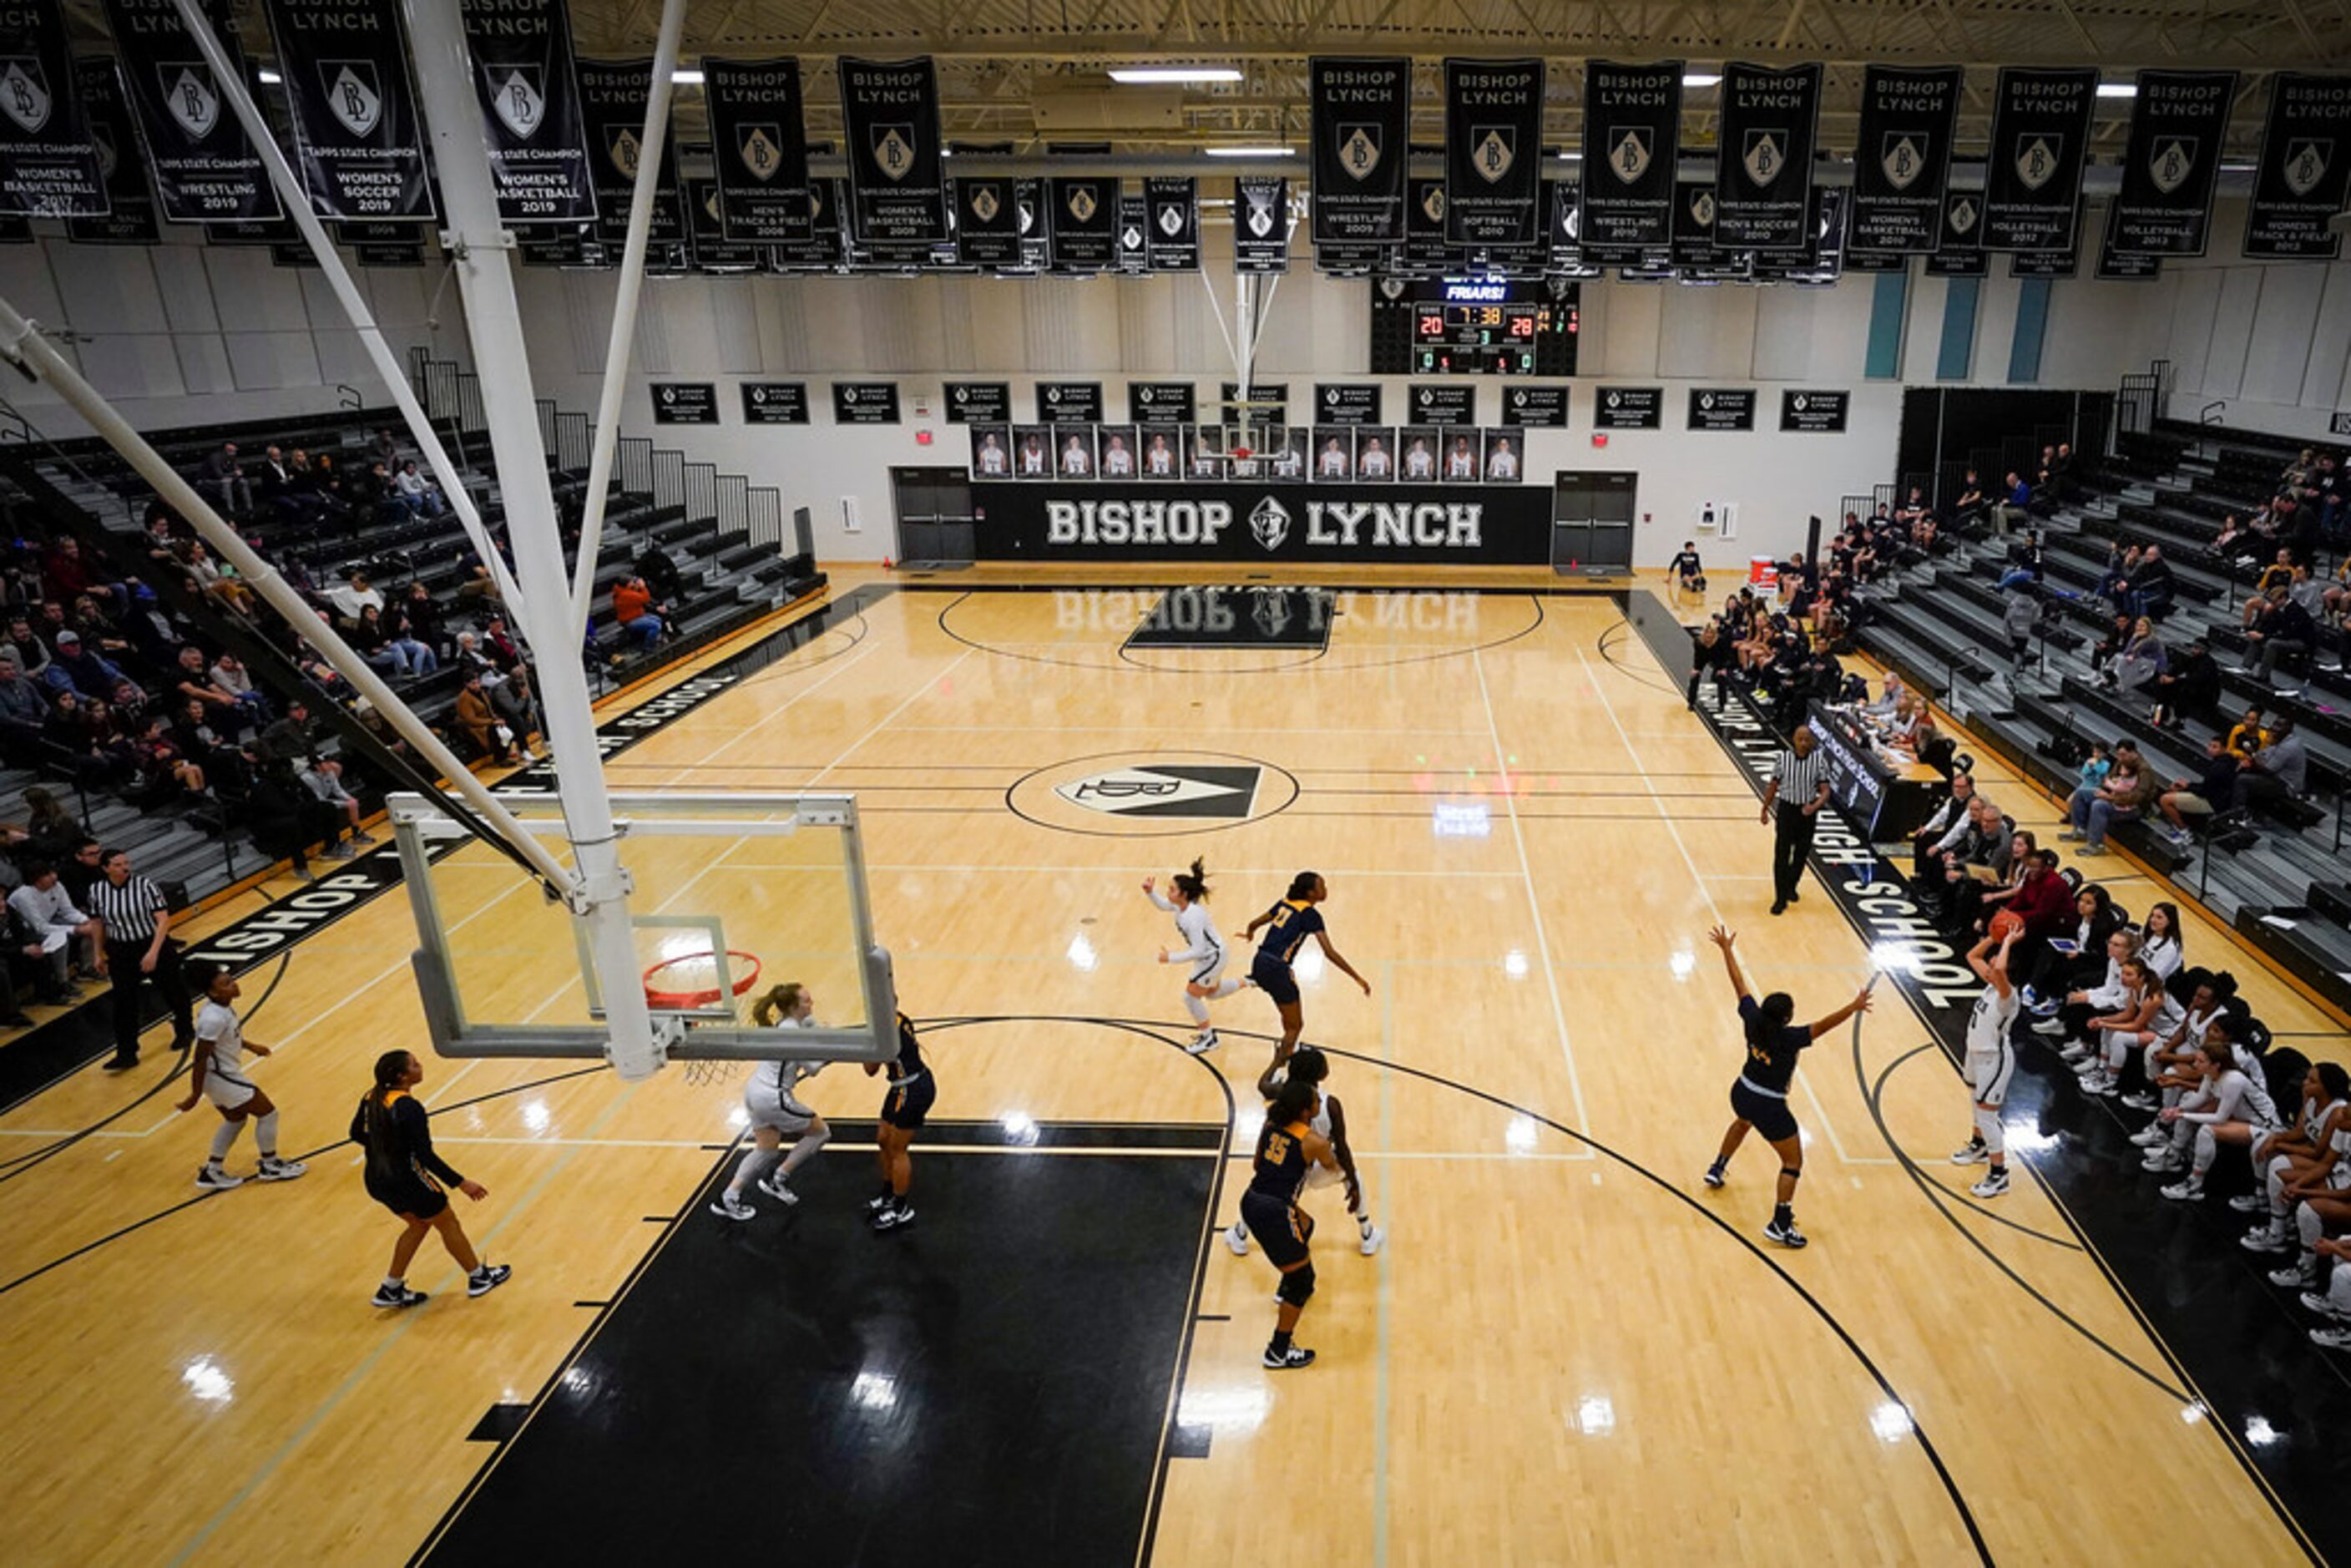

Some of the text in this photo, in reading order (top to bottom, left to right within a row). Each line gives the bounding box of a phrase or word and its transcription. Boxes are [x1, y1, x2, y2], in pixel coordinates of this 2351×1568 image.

[294, 13, 379, 30] LYNCH
[467, 18, 549, 35] LYNCH
[715, 72, 787, 85] BISHOP
[853, 73, 923, 85] BISHOP
[1323, 72, 1397, 84] BISHOP
[1459, 75, 1532, 88] BISHOP
[1598, 74, 1671, 89] BISHOP
[1737, 77, 1807, 91] BISHOP
[1876, 79, 1949, 95] BISHOP
[2011, 82, 2085, 96] BISHOP
[2149, 86, 2222, 100] BISHOP
[723, 90, 786, 102] LYNCH
[858, 90, 920, 102] LYNCH
[1326, 89, 1393, 102] LYNCH
[1462, 91, 1528, 104] LYNCH
[1601, 92, 1667, 106] LYNCH
[1737, 94, 1802, 108] LYNCH
[1878, 97, 1944, 111] LYNCH
[2014, 99, 2079, 113] LYNCH
[2149, 103, 2215, 117] LYNCH
[340, 148, 367, 157] STATE
[369, 147, 417, 158] CHAMPION
[530, 149, 583, 159] CHAMPION
[16, 168, 83, 180] WOMEN'S
[337, 173, 402, 184] WOMEN'S
[500, 174, 569, 185] WOMEN'S
[4, 181, 97, 193] BASKETBALL
[179, 184, 255, 195] WRESTLING
[343, 185, 401, 198] SOCCER
[496, 187, 581, 200] ASKETBALL
[40, 195, 73, 206] 2017
[204, 197, 238, 209] 2019
[358, 200, 392, 211] 2019
[522, 201, 557, 212] 2019
[752, 206, 786, 215] MEN'S
[877, 206, 927, 215] WOMEN'S
[730, 216, 766, 226] TRACK
[779, 216, 809, 226] FIELD
[867, 216, 936, 226] BASKETBALL
[1327, 213, 1392, 224] WRESTLING
[1463, 217, 1519, 226] SOFTBALL
[1594, 217, 1658, 227] WRESTLING
[1869, 215, 1920, 225] WOMEN'S
[889, 226, 917, 235] 2009
[1345, 225, 1374, 234] 2009
[1719, 220, 1799, 230] MEN'S SOCCER
[1859, 225, 1929, 236] BASKETBALL
[1992, 221, 2061, 233] VOLLEYBALL
[2123, 225, 2193, 236] VOLLEYBALL
[2268, 220, 2318, 230] WOMEN'S
[1478, 227, 1504, 236] 2010
[1611, 228, 1639, 237] 2010
[1744, 230, 1771, 240] 2010
[2011, 232, 2038, 243] 2012
[2298, 232, 2332, 241] FIELD
[1878, 235, 1906, 245] 2010
[1460, 306, 1501, 325] 7:38
[1421, 316, 1443, 334] 20
[1511, 318, 1533, 336] 28
[1480, 330, 1490, 345] 3
[1046, 500, 1484, 546] BISHOP LYNCH
[616, 675, 738, 726] SCHOOL
[185, 873, 380, 970] ISHOP
[1843, 881, 1984, 1009] SCHOOL
